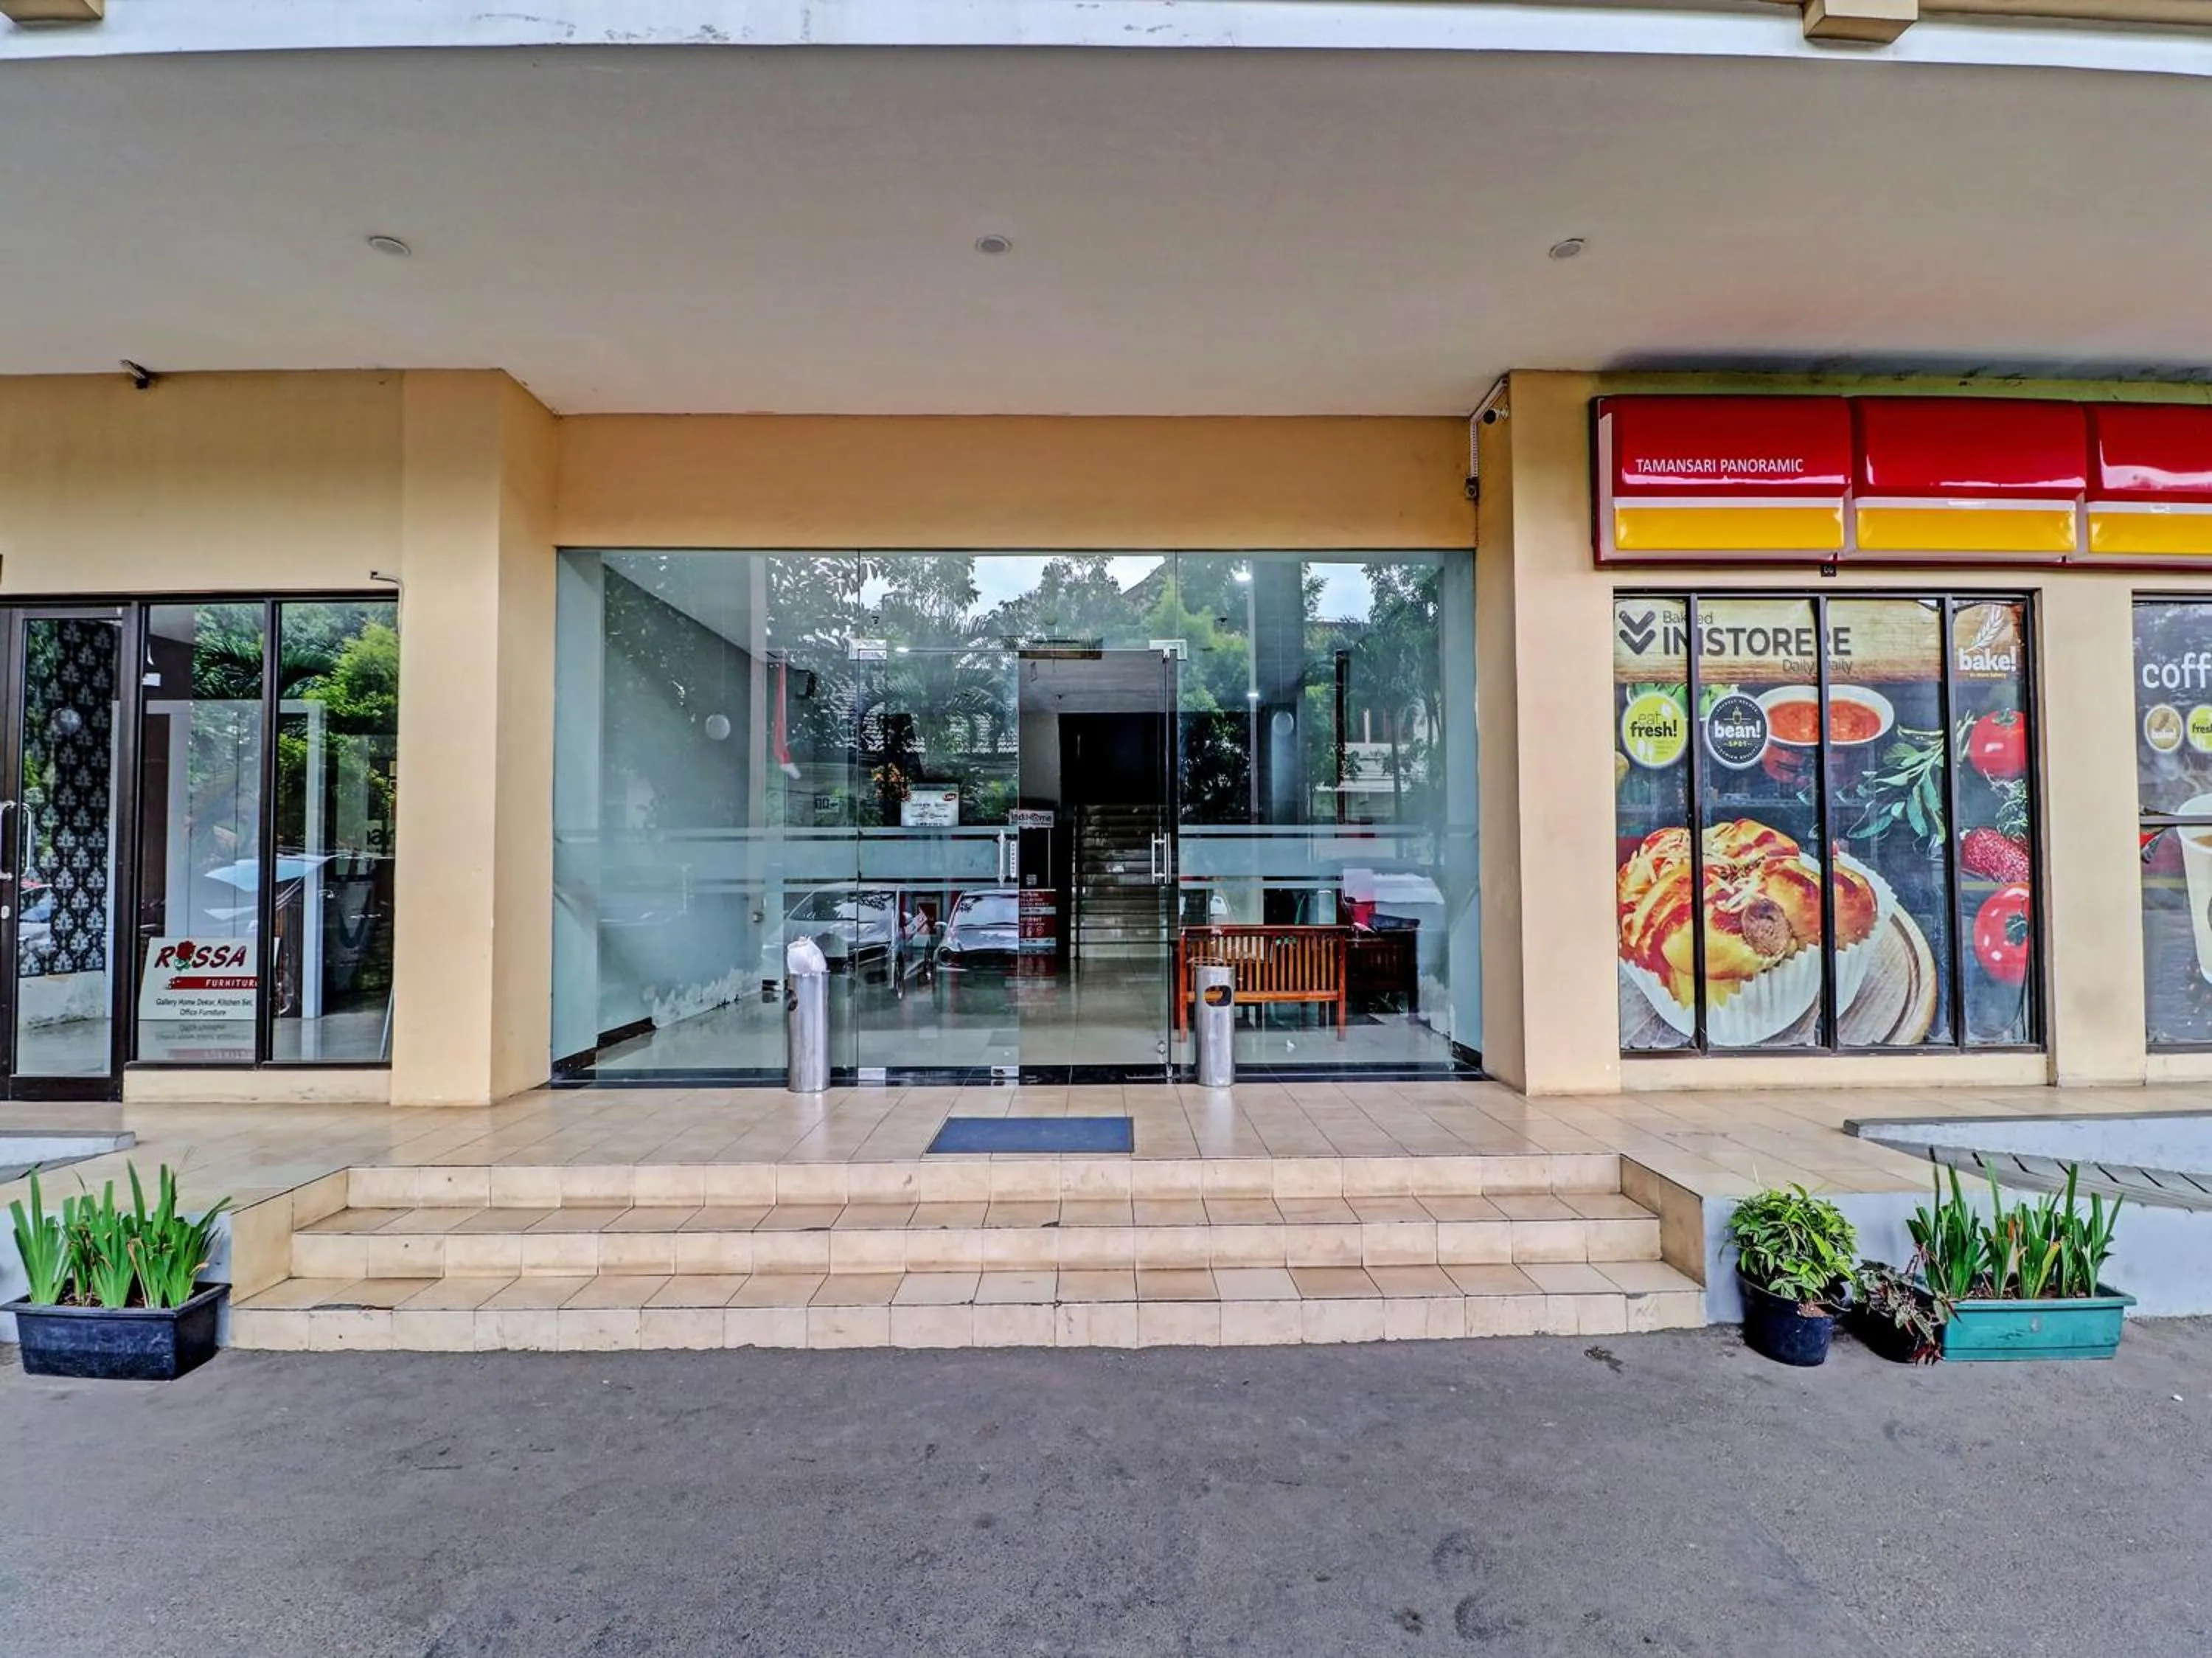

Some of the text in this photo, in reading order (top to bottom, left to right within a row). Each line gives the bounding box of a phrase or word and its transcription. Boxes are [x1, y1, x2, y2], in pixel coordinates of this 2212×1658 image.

[1635, 458, 1804, 473] TAMANSARI PANORAMIC
[1958, 646, 2017, 672] bake!
[1638, 711, 1661, 725] eat
[1630, 719, 1677, 738] fresh!
[1714, 720, 1761, 738] bean!
